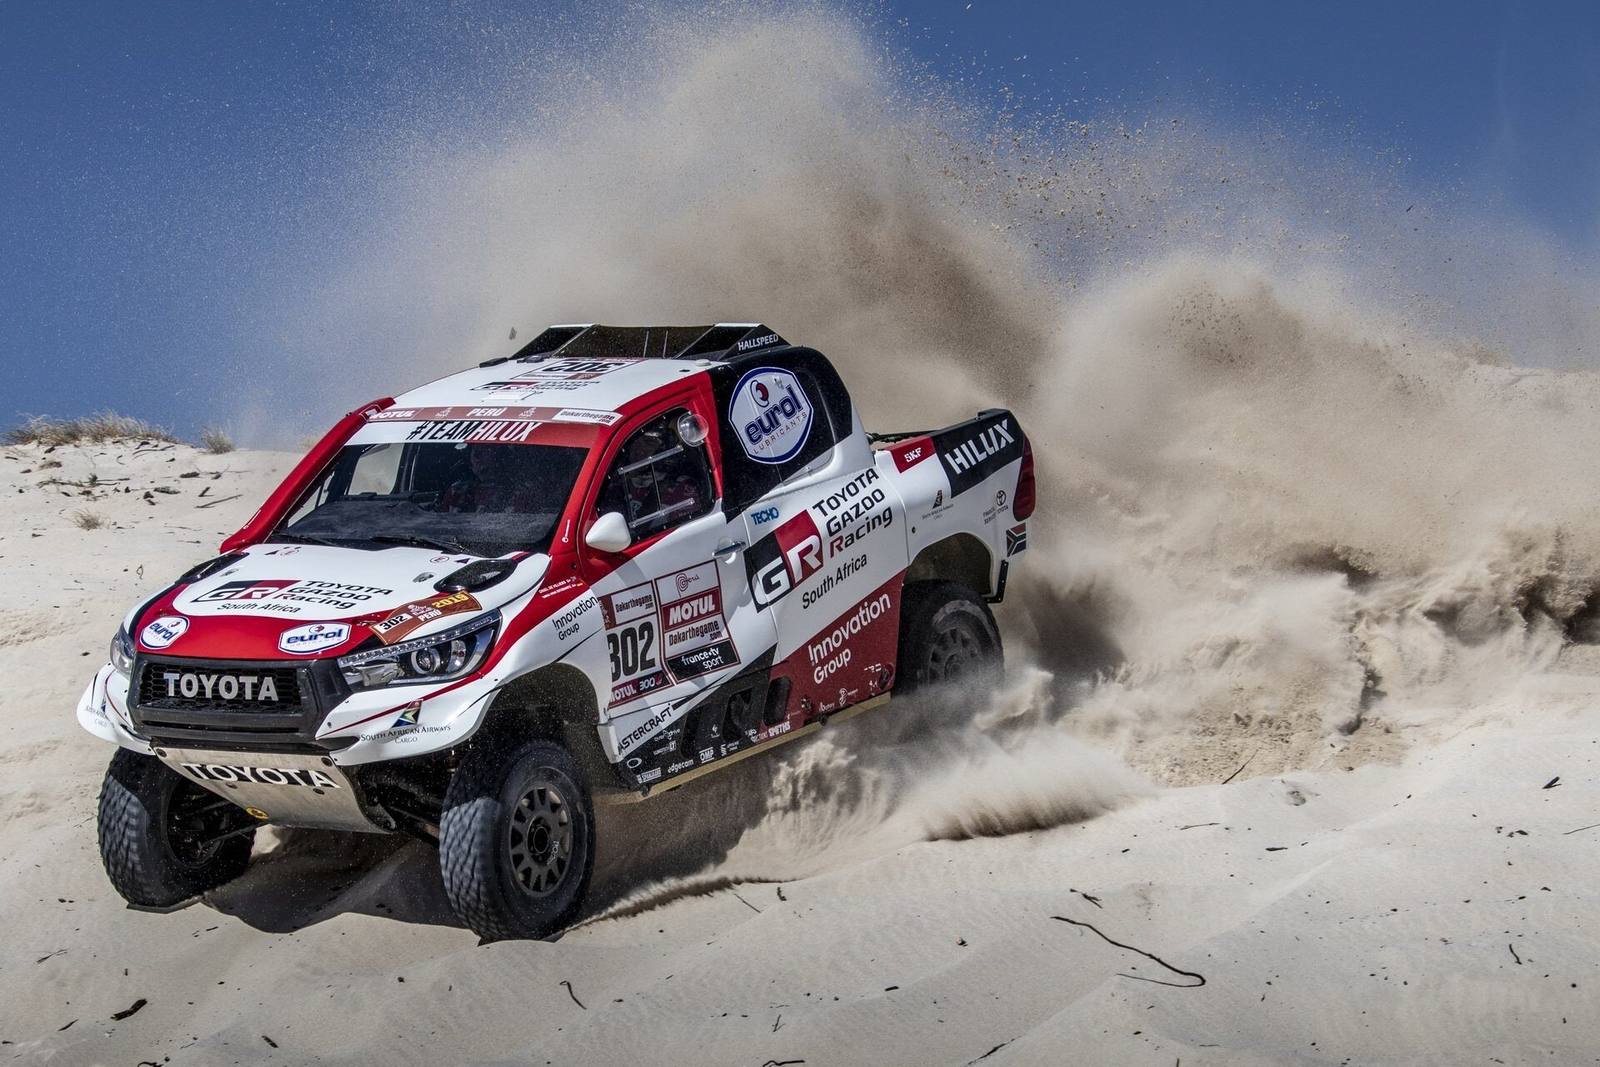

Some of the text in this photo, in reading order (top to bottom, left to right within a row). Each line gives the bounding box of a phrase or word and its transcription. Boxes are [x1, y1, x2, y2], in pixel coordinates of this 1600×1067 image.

[738, 334, 779, 351] HALLSPEED
[745, 384, 803, 445] eurol
[405, 420, 542, 442] #TEAMHILUX
[753, 412, 807, 454] LUBRICANTS
[904, 446, 923, 464] SKF
[944, 419, 1015, 475] HILUX
[812, 467, 880, 518] TOYOTA
[751, 506, 779, 525] TECHO
[826, 488, 885, 537] GAZOO
[830, 507, 893, 558] Racing
[287, 587, 372, 601] GAZOO
[304, 580, 394, 595] TOYOTA
[802, 554, 867, 610] South Africa
[217, 602, 302, 614] South Africa
[273, 593, 357, 610] Racing
[380, 615, 408, 630] 302
[431, 593, 470, 608] 2019
[552, 596, 599, 630] Innovation
[615, 593, 653, 613] Dakarthegame
[669, 594, 716, 627] MOTUL
[149, 622, 180, 642] eurol
[287, 629, 343, 645] eurol
[558, 622, 580, 640] Group
[669, 619, 720, 646] Dakarthegame
[709, 630, 723, 641] .com
[808, 593, 892, 665] Innovation
[607, 621, 656, 682] 302
[702, 655, 724, 670] sport
[813, 648, 852, 685] Group
[163, 672, 279, 702] TOYOTA
[361, 726, 452, 742] SOUTH AFRICAN AIRWAYS
[617, 707, 672, 756] ASTERCRAFT
[699, 749, 714, 762] OMP
[180, 762, 342, 789] TOYOTA
